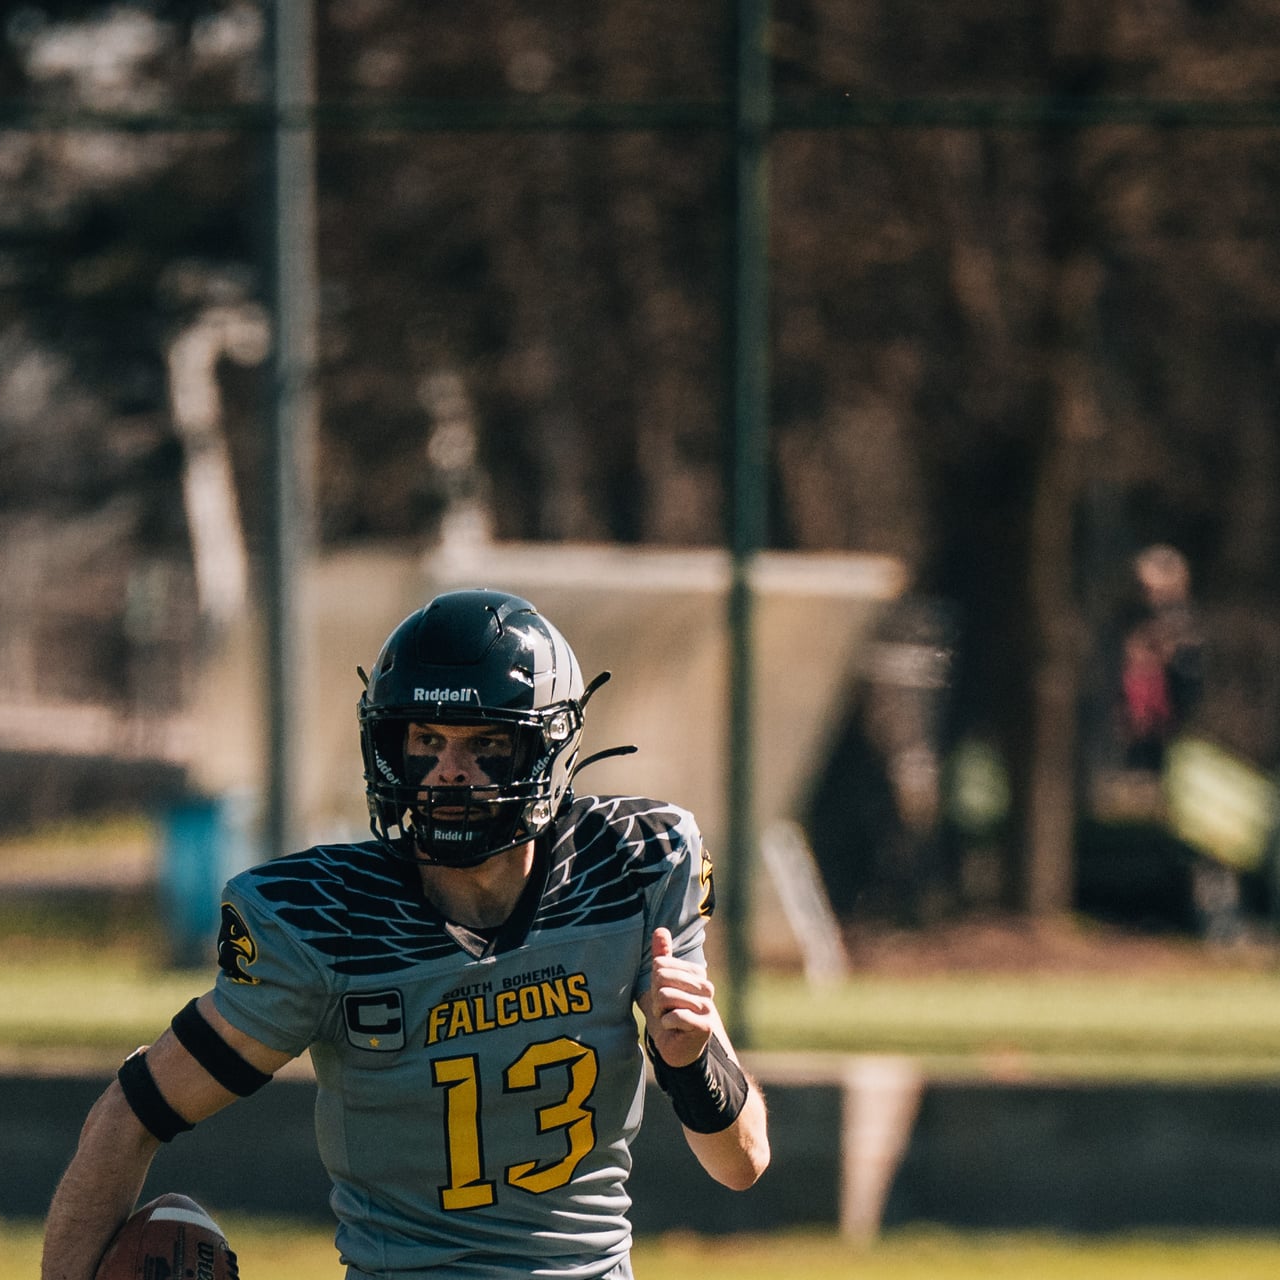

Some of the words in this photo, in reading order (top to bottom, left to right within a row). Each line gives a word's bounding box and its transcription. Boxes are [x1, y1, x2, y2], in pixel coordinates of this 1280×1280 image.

[414, 688, 472, 701] Riddell
[442, 980, 493, 999] SOUTH
[502, 964, 567, 990] BOHEMIA
[345, 993, 402, 1035] C
[424, 972, 592, 1048] FALCONS
[429, 1035, 600, 1212] 13
